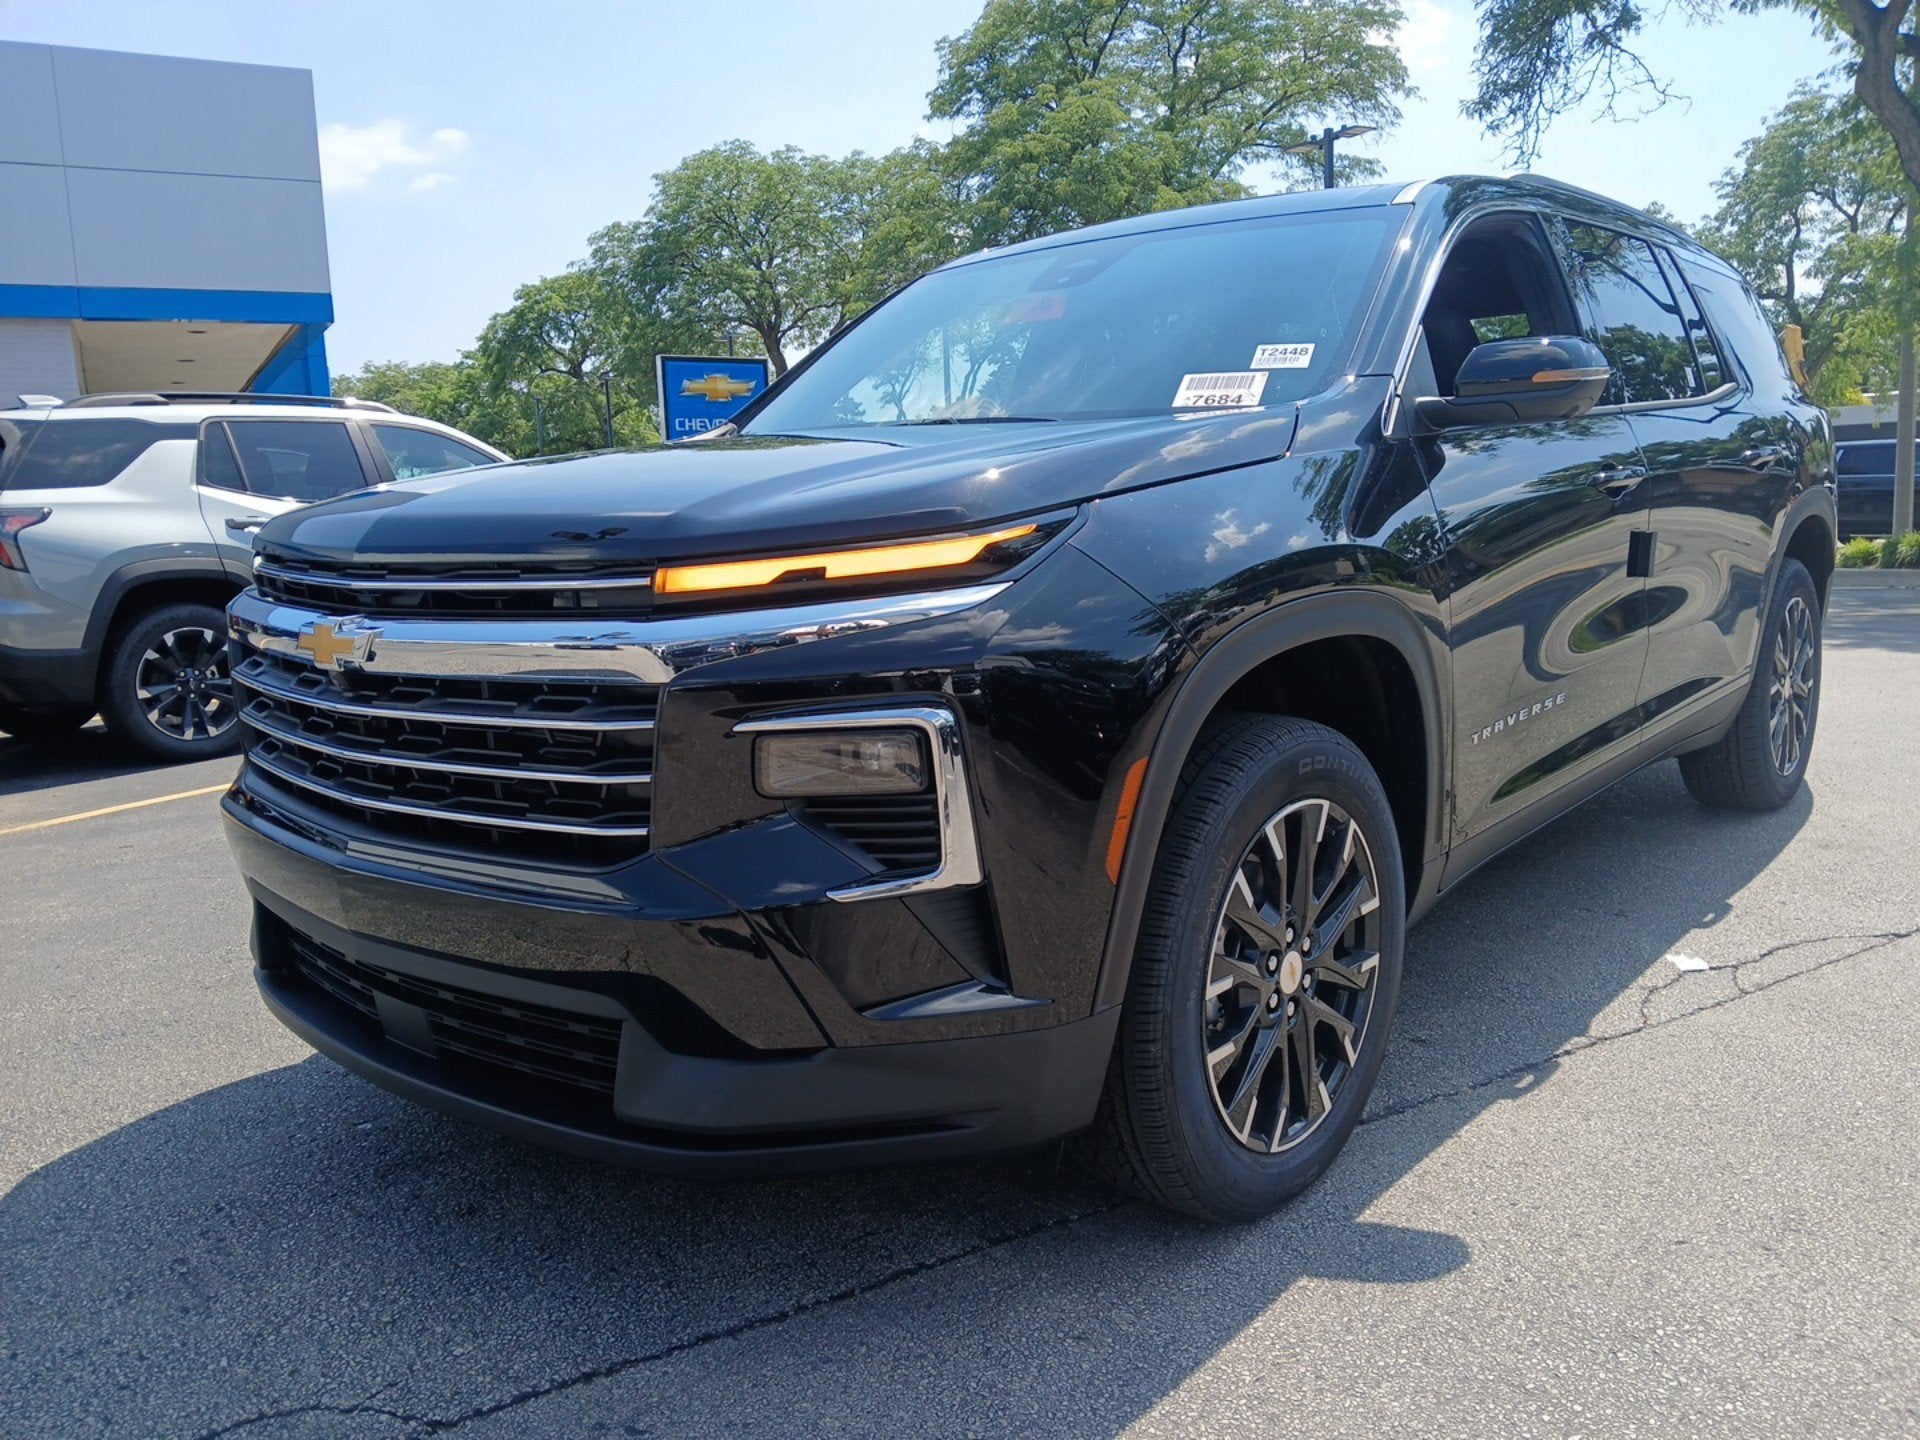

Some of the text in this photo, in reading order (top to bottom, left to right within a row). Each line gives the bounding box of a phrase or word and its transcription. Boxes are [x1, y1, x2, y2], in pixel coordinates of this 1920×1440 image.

[1260, 347, 1309, 356] T2448
[1192, 394, 1243, 405] 7684
[1471, 692, 1566, 745] TRAVERSE
